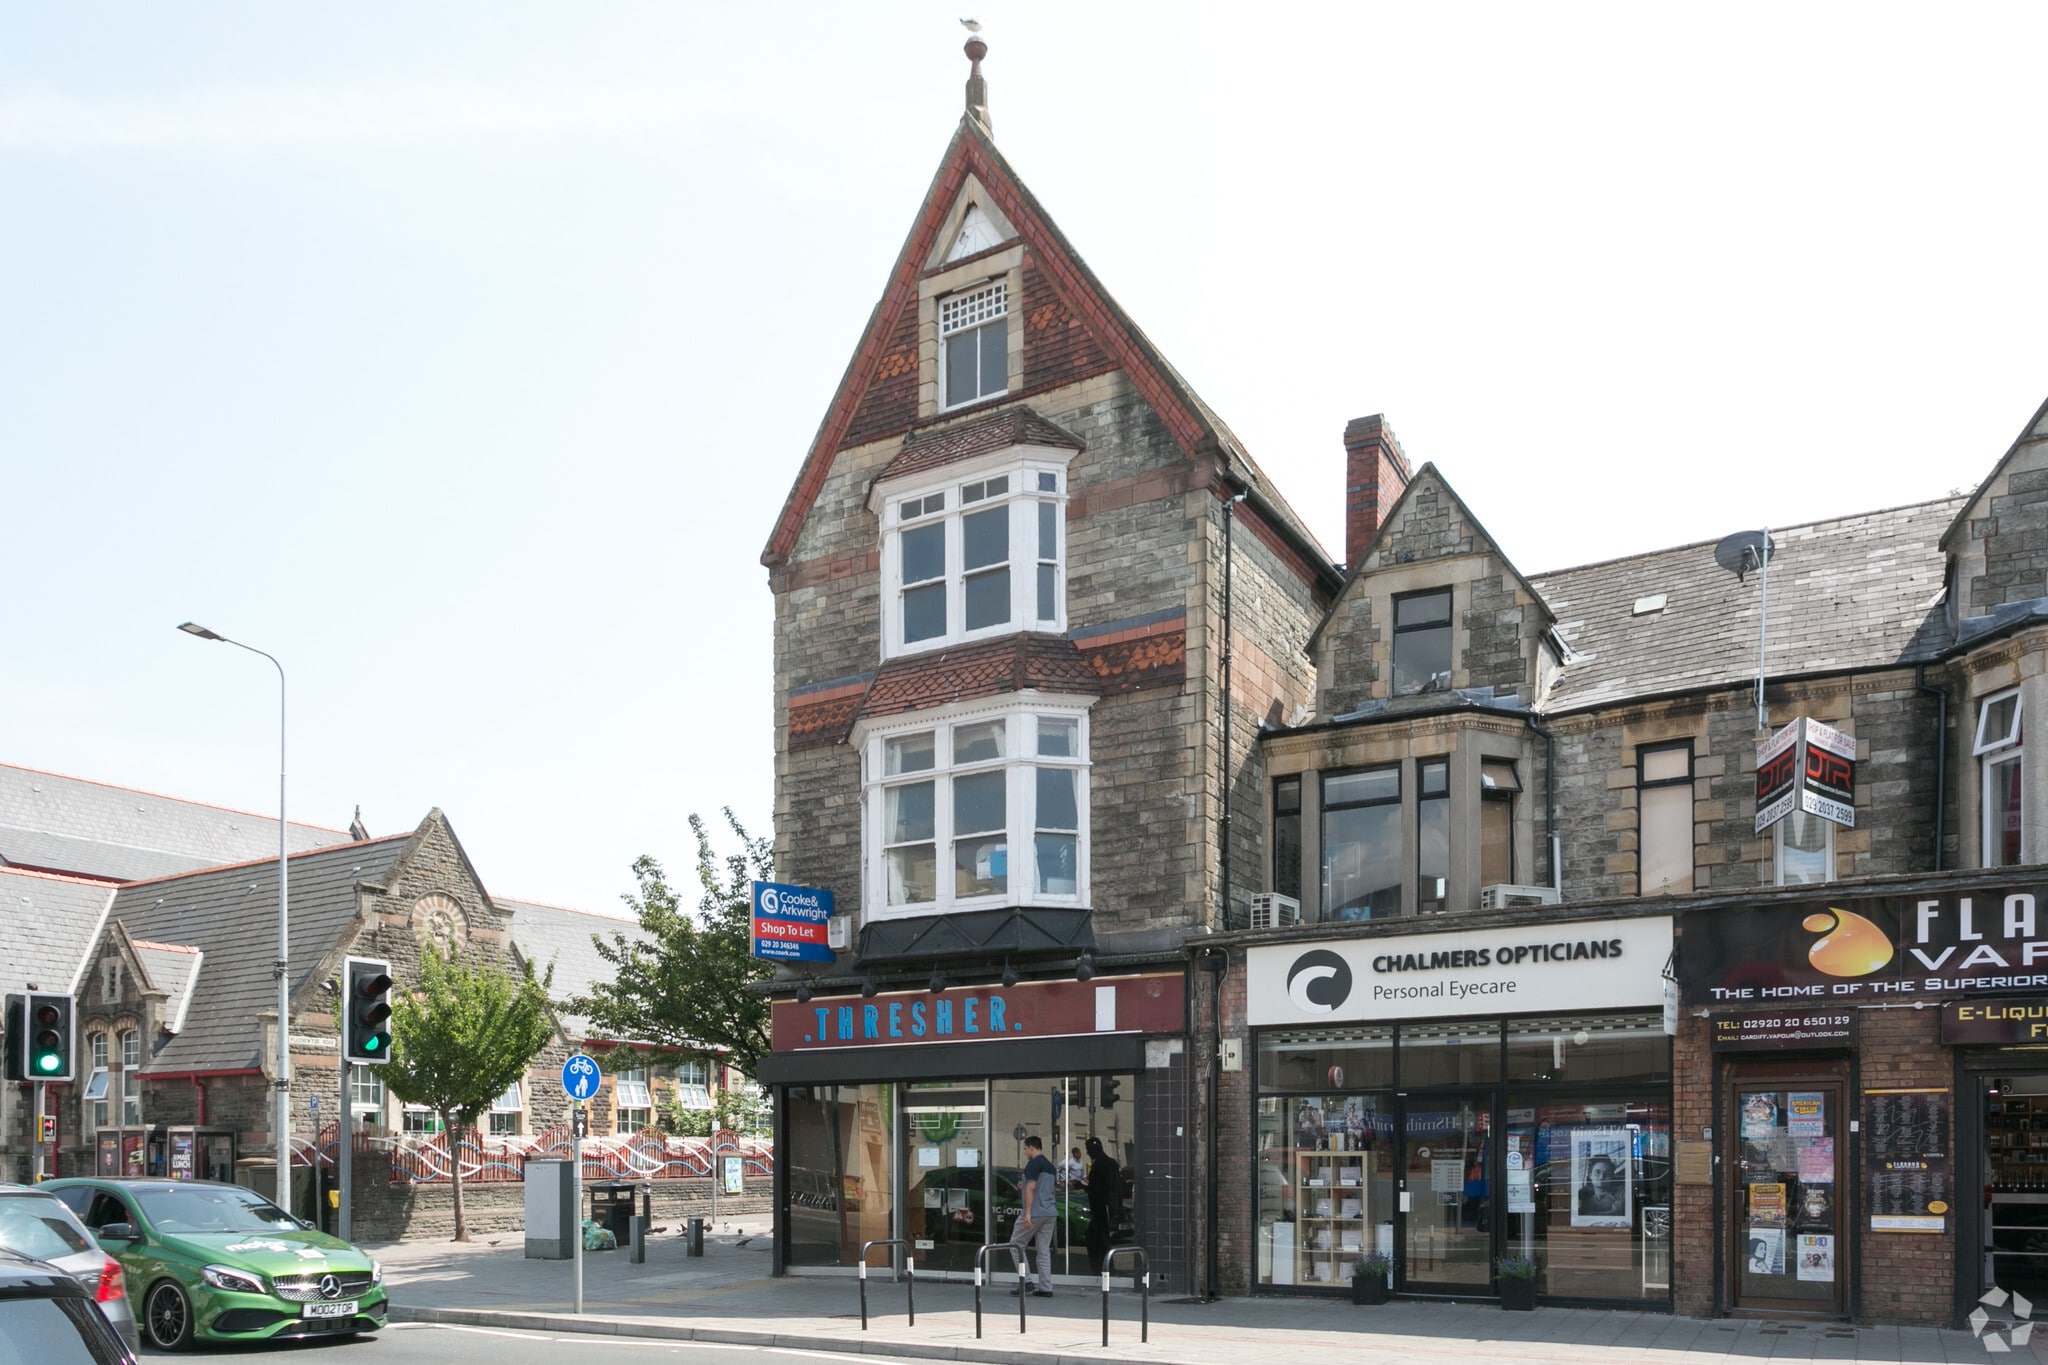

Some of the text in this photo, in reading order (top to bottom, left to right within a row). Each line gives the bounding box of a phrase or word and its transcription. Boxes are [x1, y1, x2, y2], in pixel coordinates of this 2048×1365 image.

[1818, 799, 1834, 816] 2037
[1836, 805, 1853, 823] 2599
[780, 904, 828, 920] Arkwright
[761, 922, 814, 937] Shop To Let
[761, 940, 800, 950] 029 20 346346
[1372, 939, 1623, 973] CHALMERS OPTICIANS
[1374, 980, 1517, 1000] Personal Eyecare
[1717, 1016, 1850, 1030] TEL: 02920 20 650129
